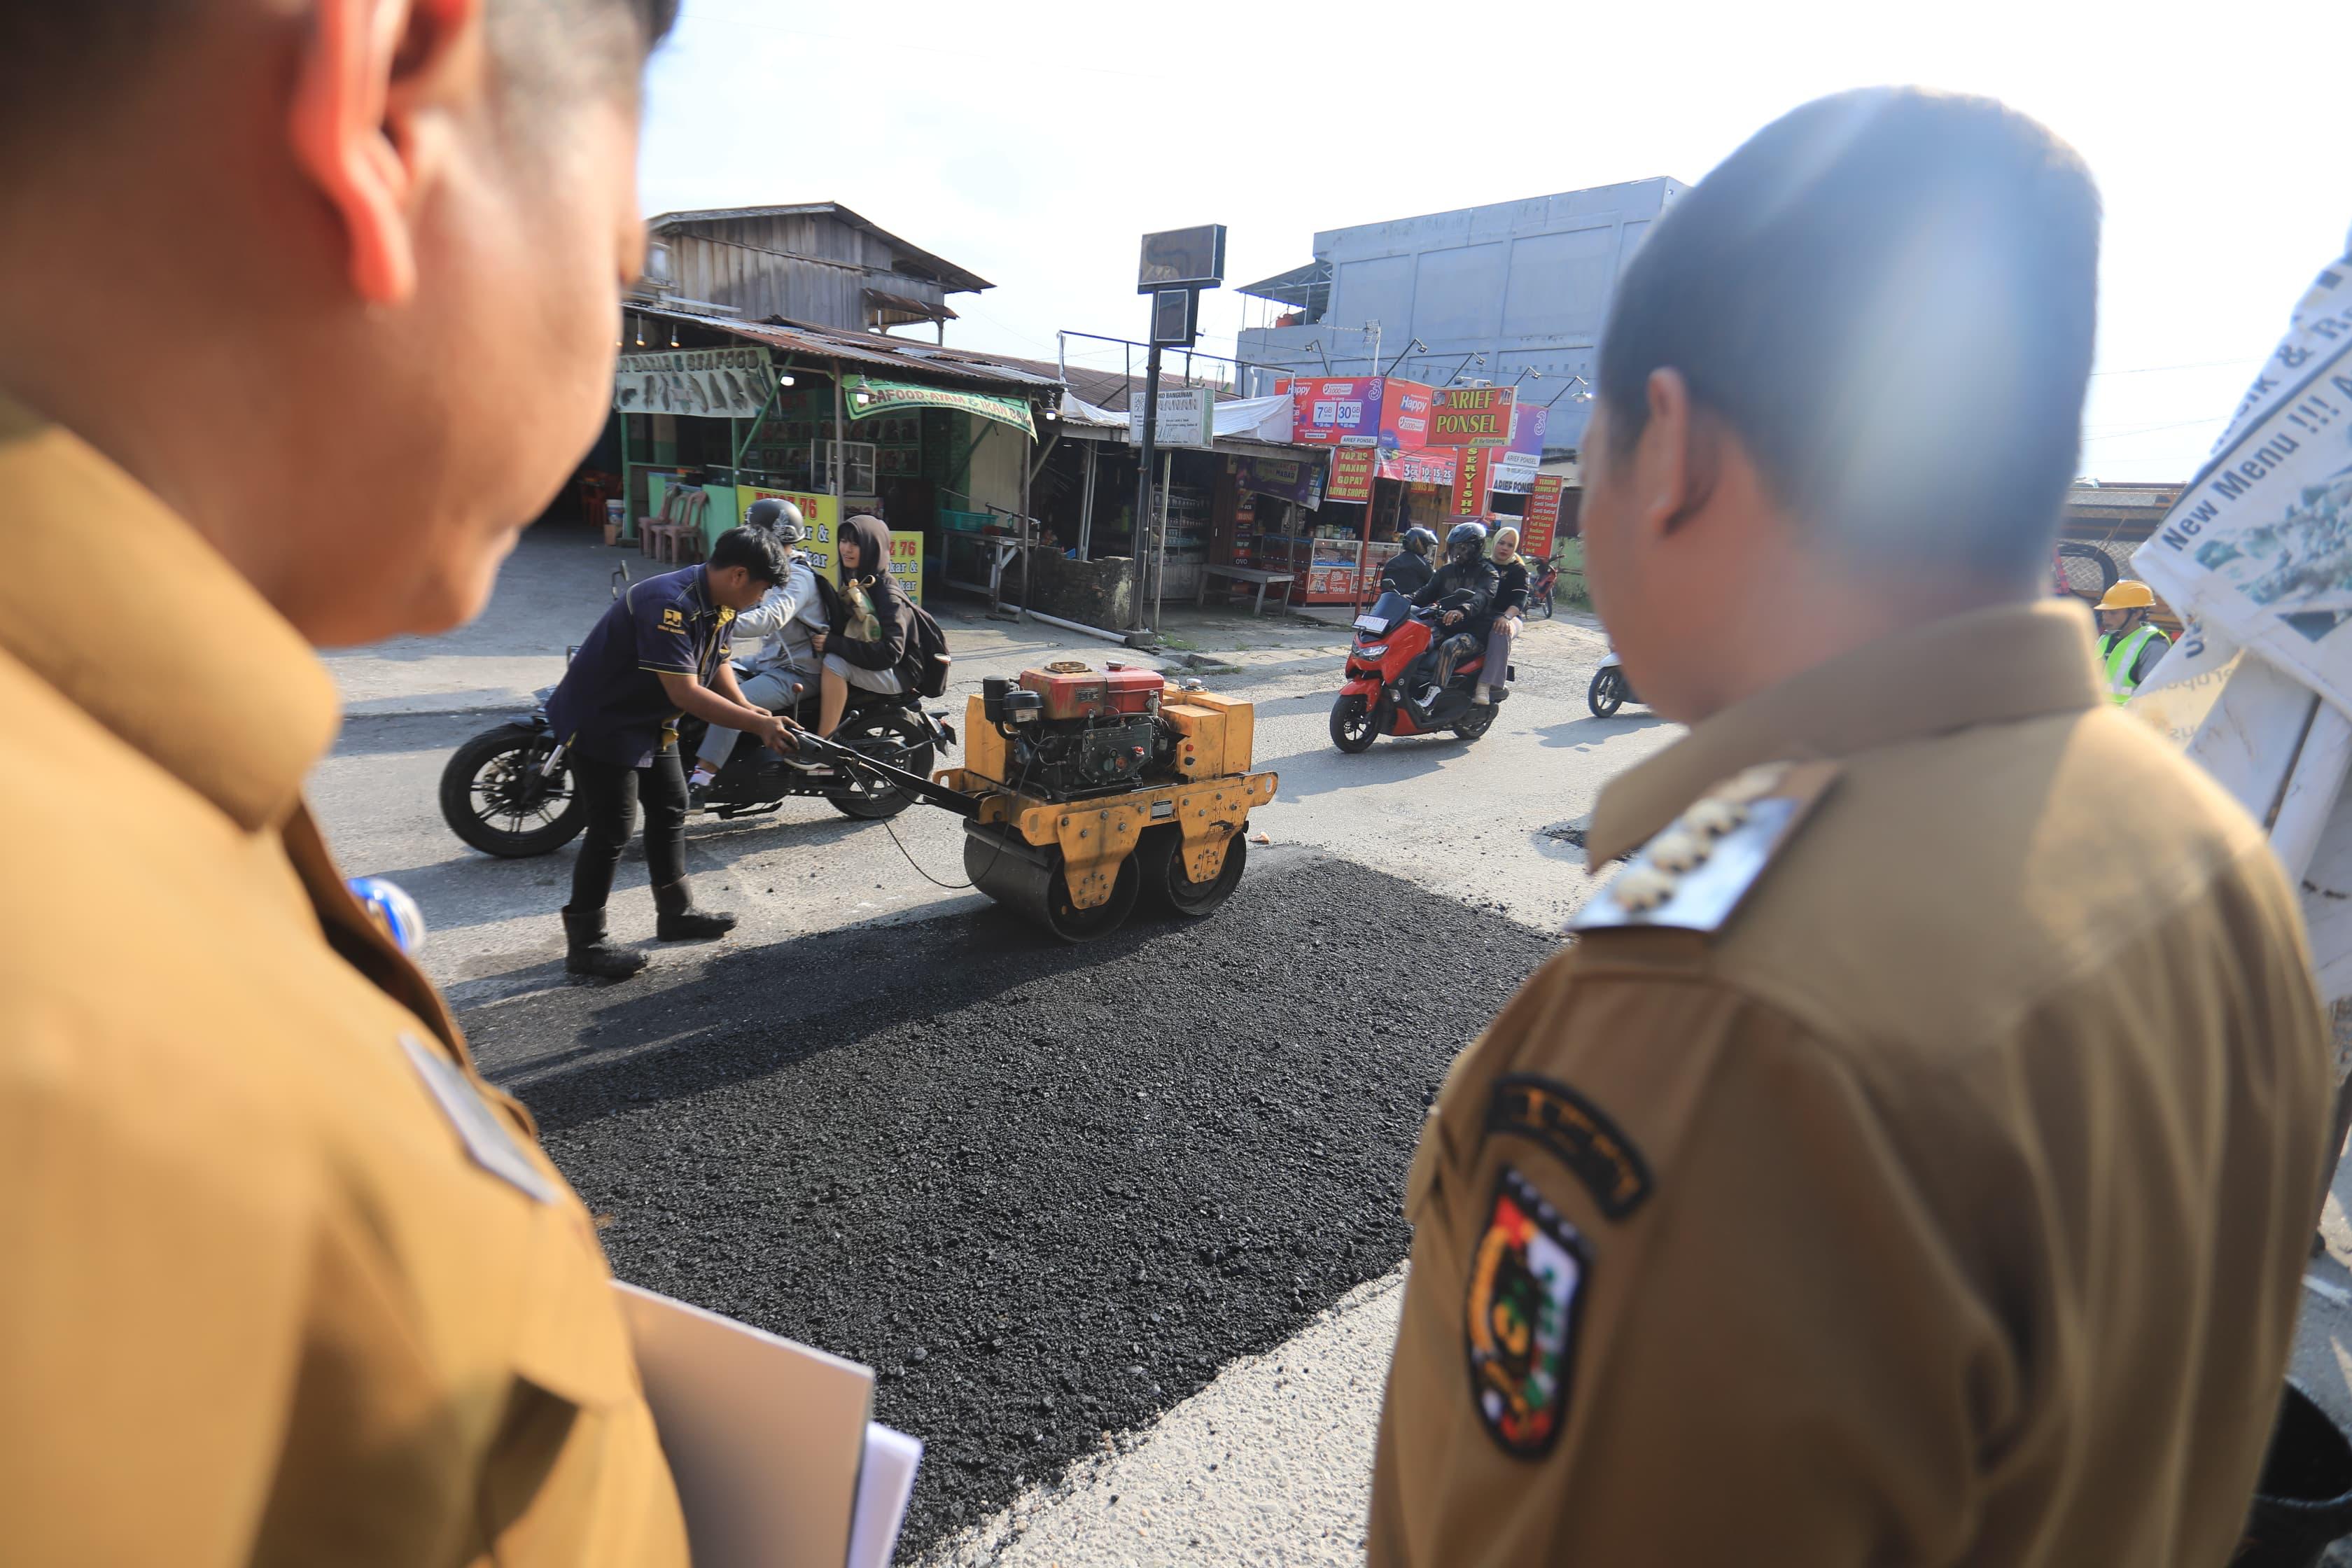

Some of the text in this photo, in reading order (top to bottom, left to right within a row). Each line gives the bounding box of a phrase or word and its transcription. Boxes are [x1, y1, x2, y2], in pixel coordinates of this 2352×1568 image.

[1400, 396, 1427, 412] Happy
[1447, 390, 1495, 410] ARIEF
[981, 400, 1008, 416] IKAN
[1317, 407, 1324, 419] 7
[1338, 406, 1352, 419] 30
[1436, 414, 1501, 433] PONSEL
[1338, 463, 1367, 473] MAXIM
[1422, 467, 1451, 478] 10 15 25
[1462, 448, 1478, 498] SERVIS
[2160, 499, 2219, 552] New
[2210, 431, 2301, 502] Menu
[2286, 394, 2342, 434] !!!
[1336, 476, 1364, 484] GOPAY
[1494, 479, 1534, 493] ARIEF PONSE
[1329, 487, 1368, 498] BAYAR SHOPEE
[799, 496, 818, 519] 76
[1460, 500, 1474, 515] HP
[818, 524, 829, 542] &
[900, 540, 916, 556] 76
[910, 560, 918, 573] &
